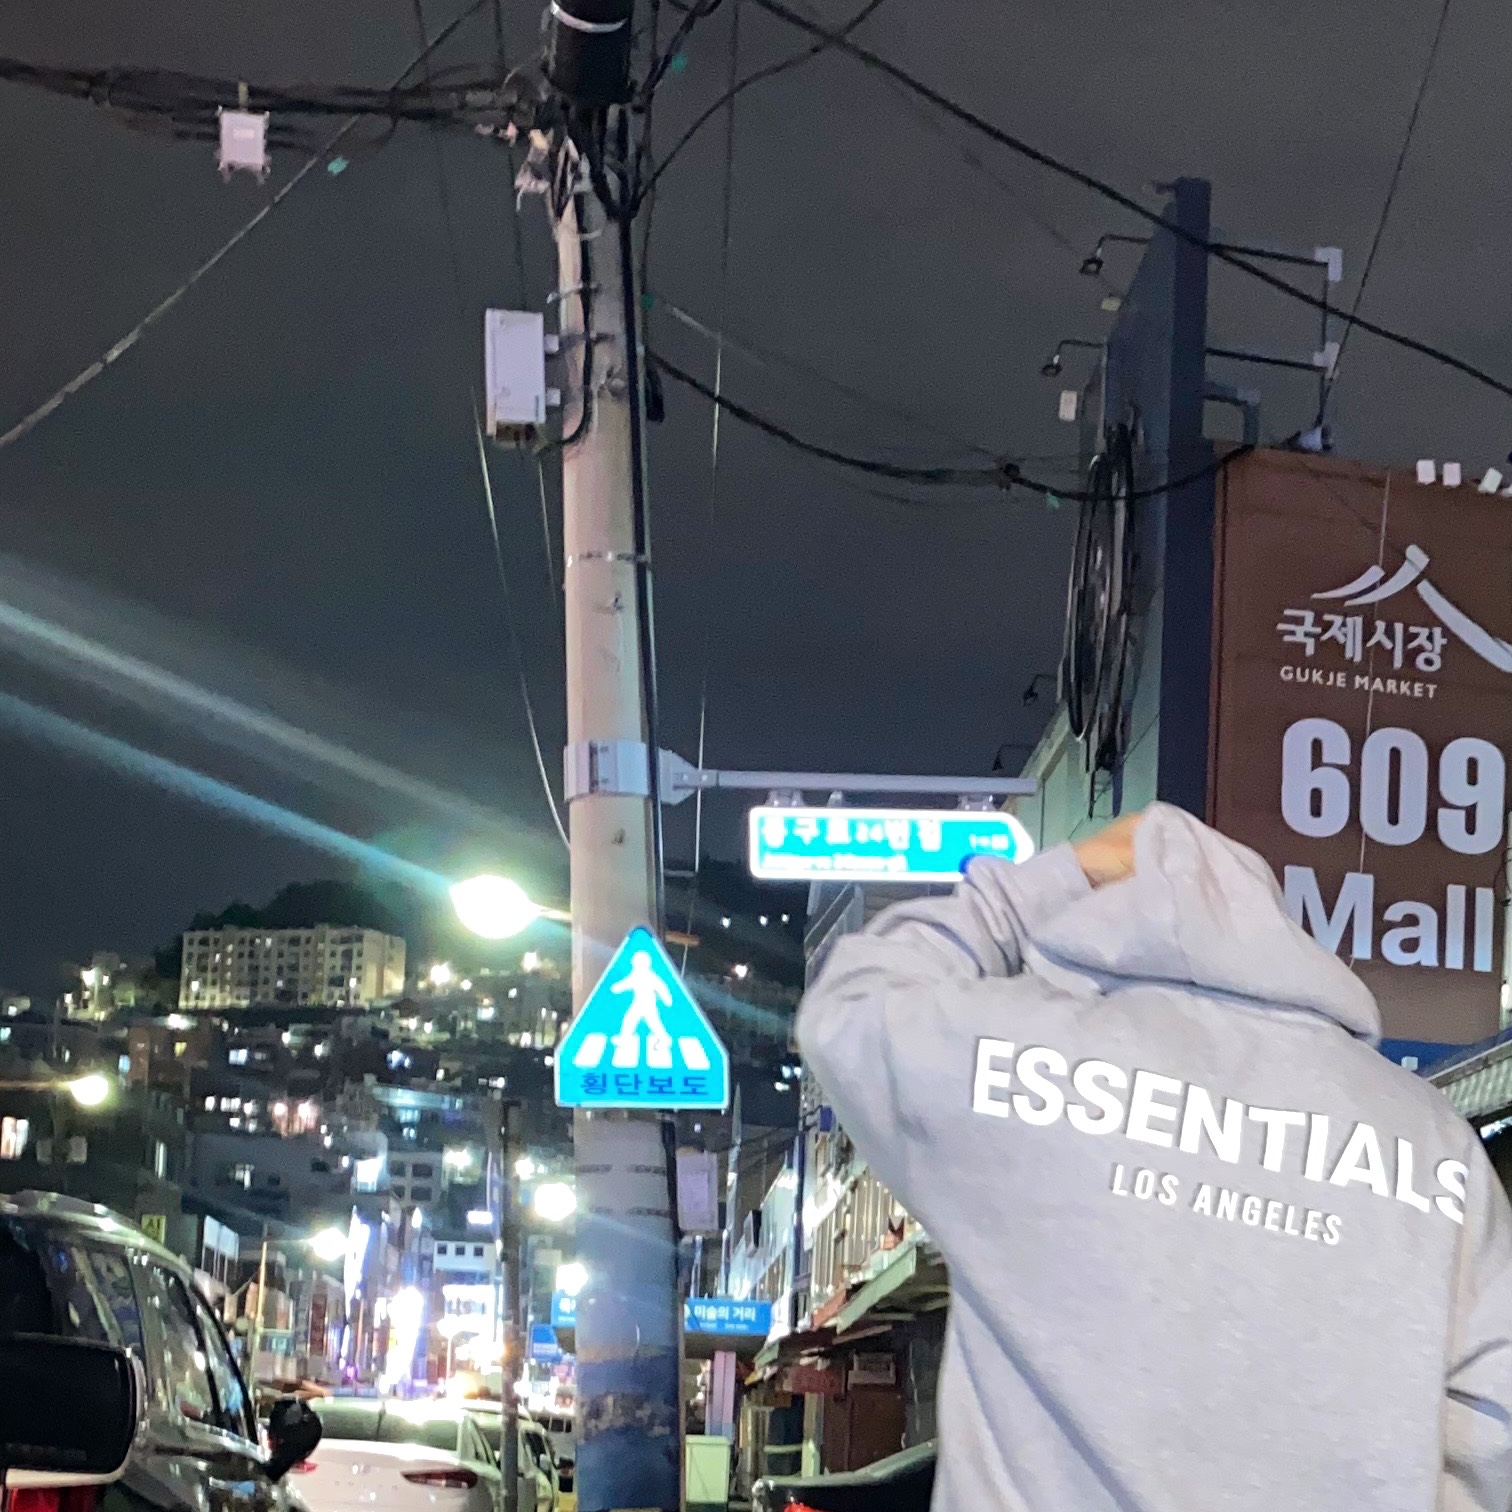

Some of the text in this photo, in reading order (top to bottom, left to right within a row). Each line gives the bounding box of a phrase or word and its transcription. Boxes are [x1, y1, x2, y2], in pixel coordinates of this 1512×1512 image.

[1275, 607, 1449, 674] 국제시장
[1279, 665, 1439, 700] GUKJE MARKET
[1280, 717, 1507, 855] 609
[1283, 864, 1495, 974] Mall
[579, 1072, 710, 1097] 횡단보도
[972, 1037, 1472, 1226] ESSENTIALS
[1111, 1162, 1343, 1247] LOS ANGELES
